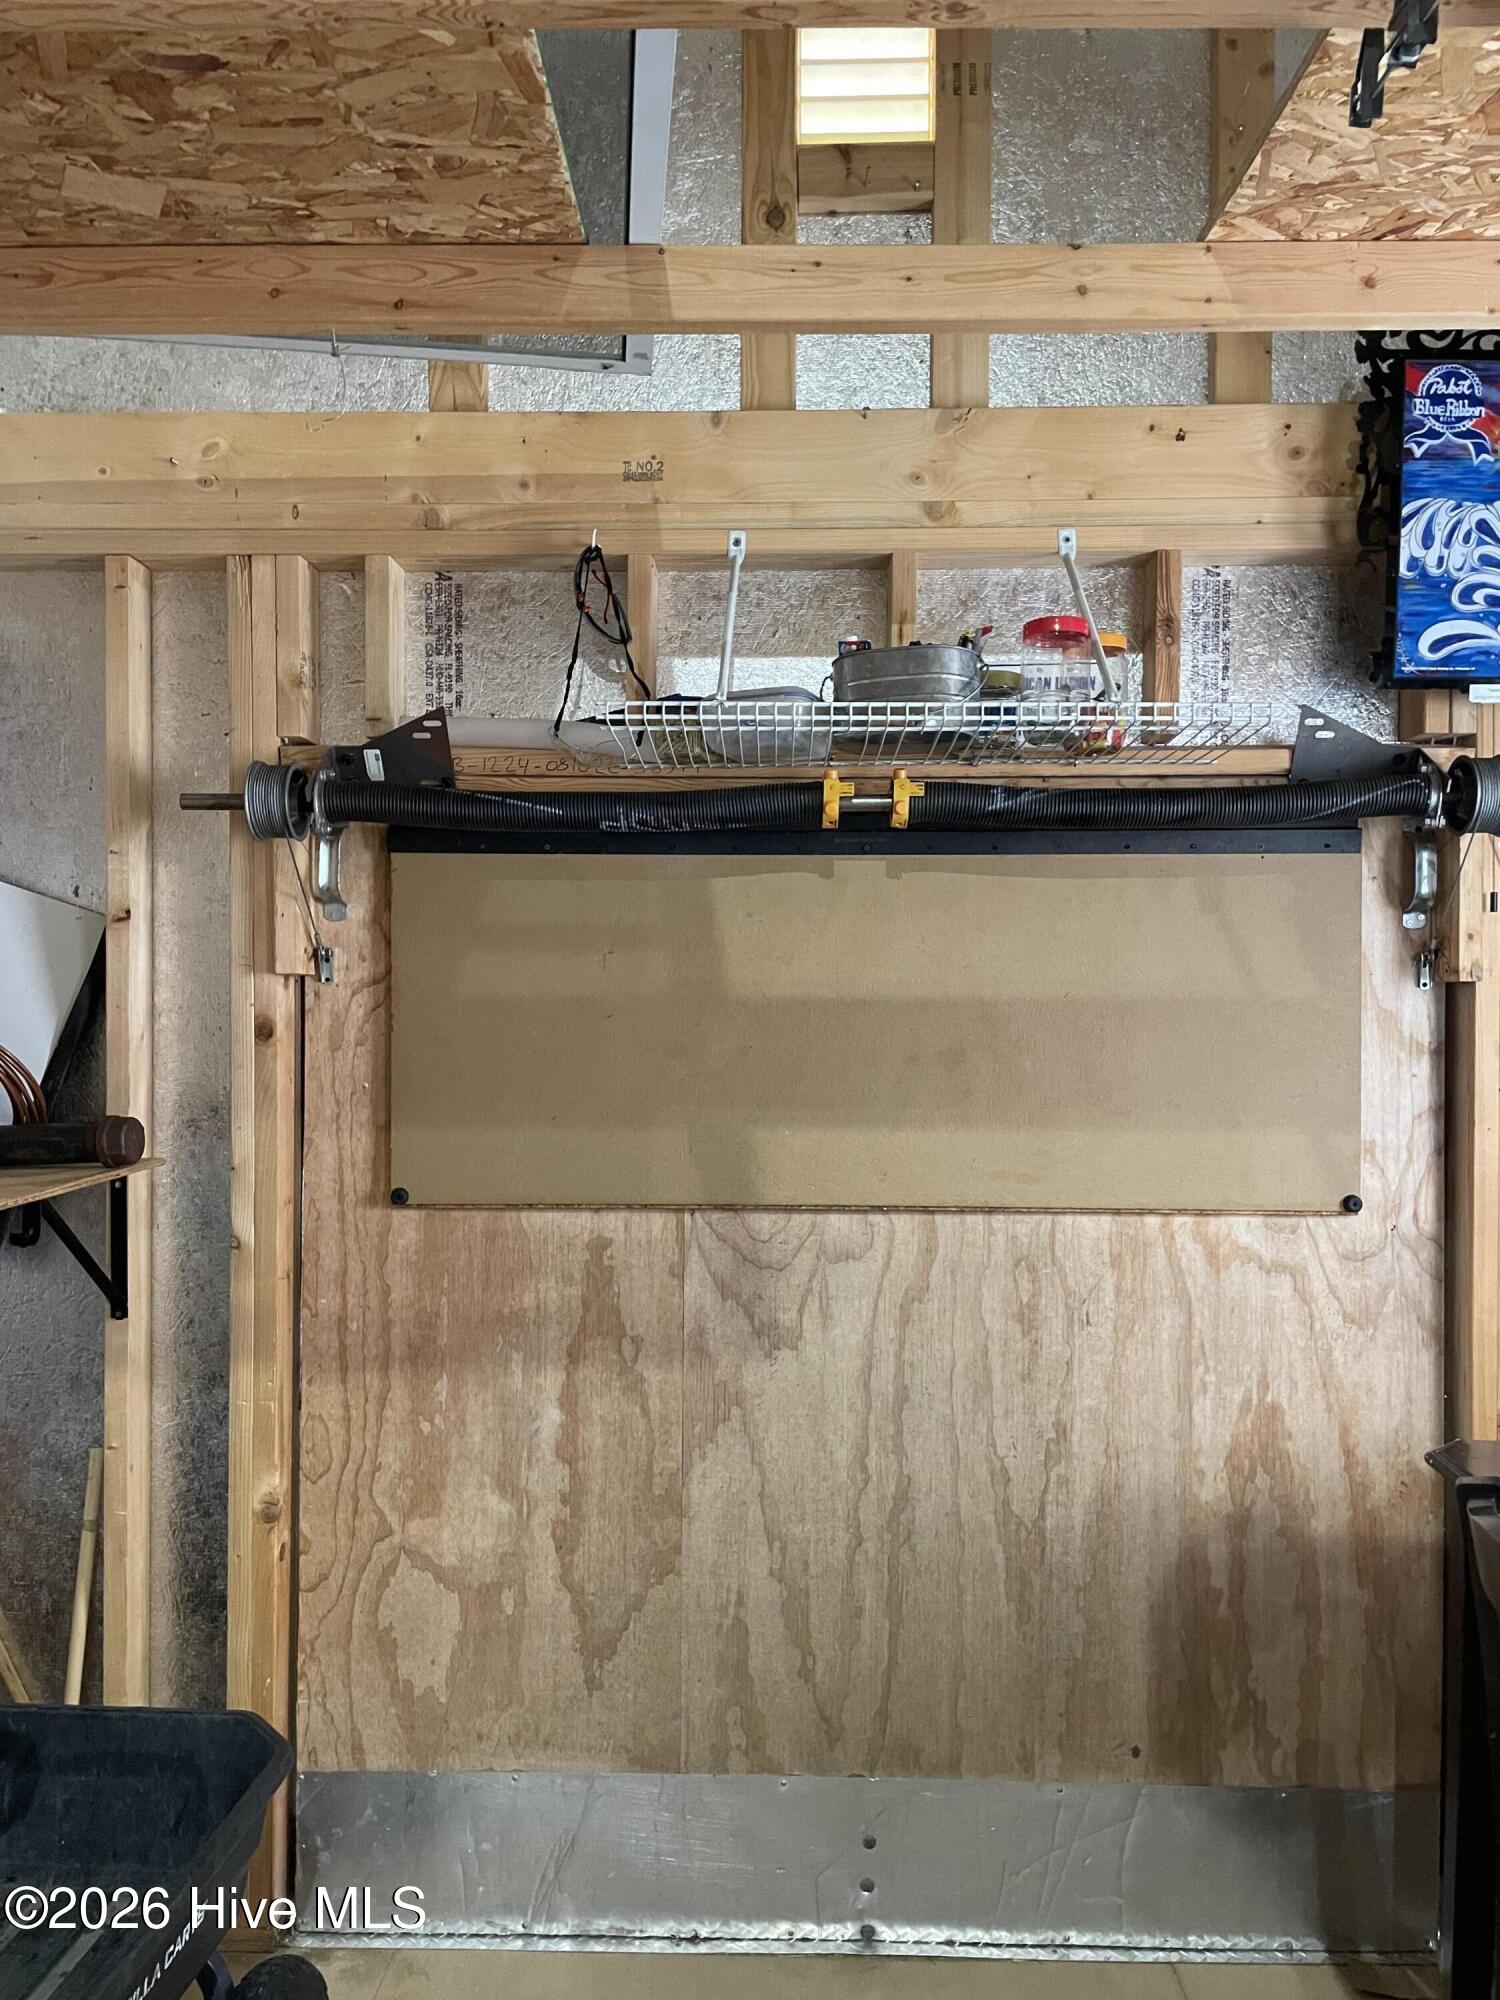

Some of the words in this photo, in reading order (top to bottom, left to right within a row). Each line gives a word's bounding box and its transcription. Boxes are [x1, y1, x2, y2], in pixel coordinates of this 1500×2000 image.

[1423, 376, 1473, 395] Pabst
[1413, 398, 1446, 416] Blue
[1446, 398, 1486, 418] Ribbon
